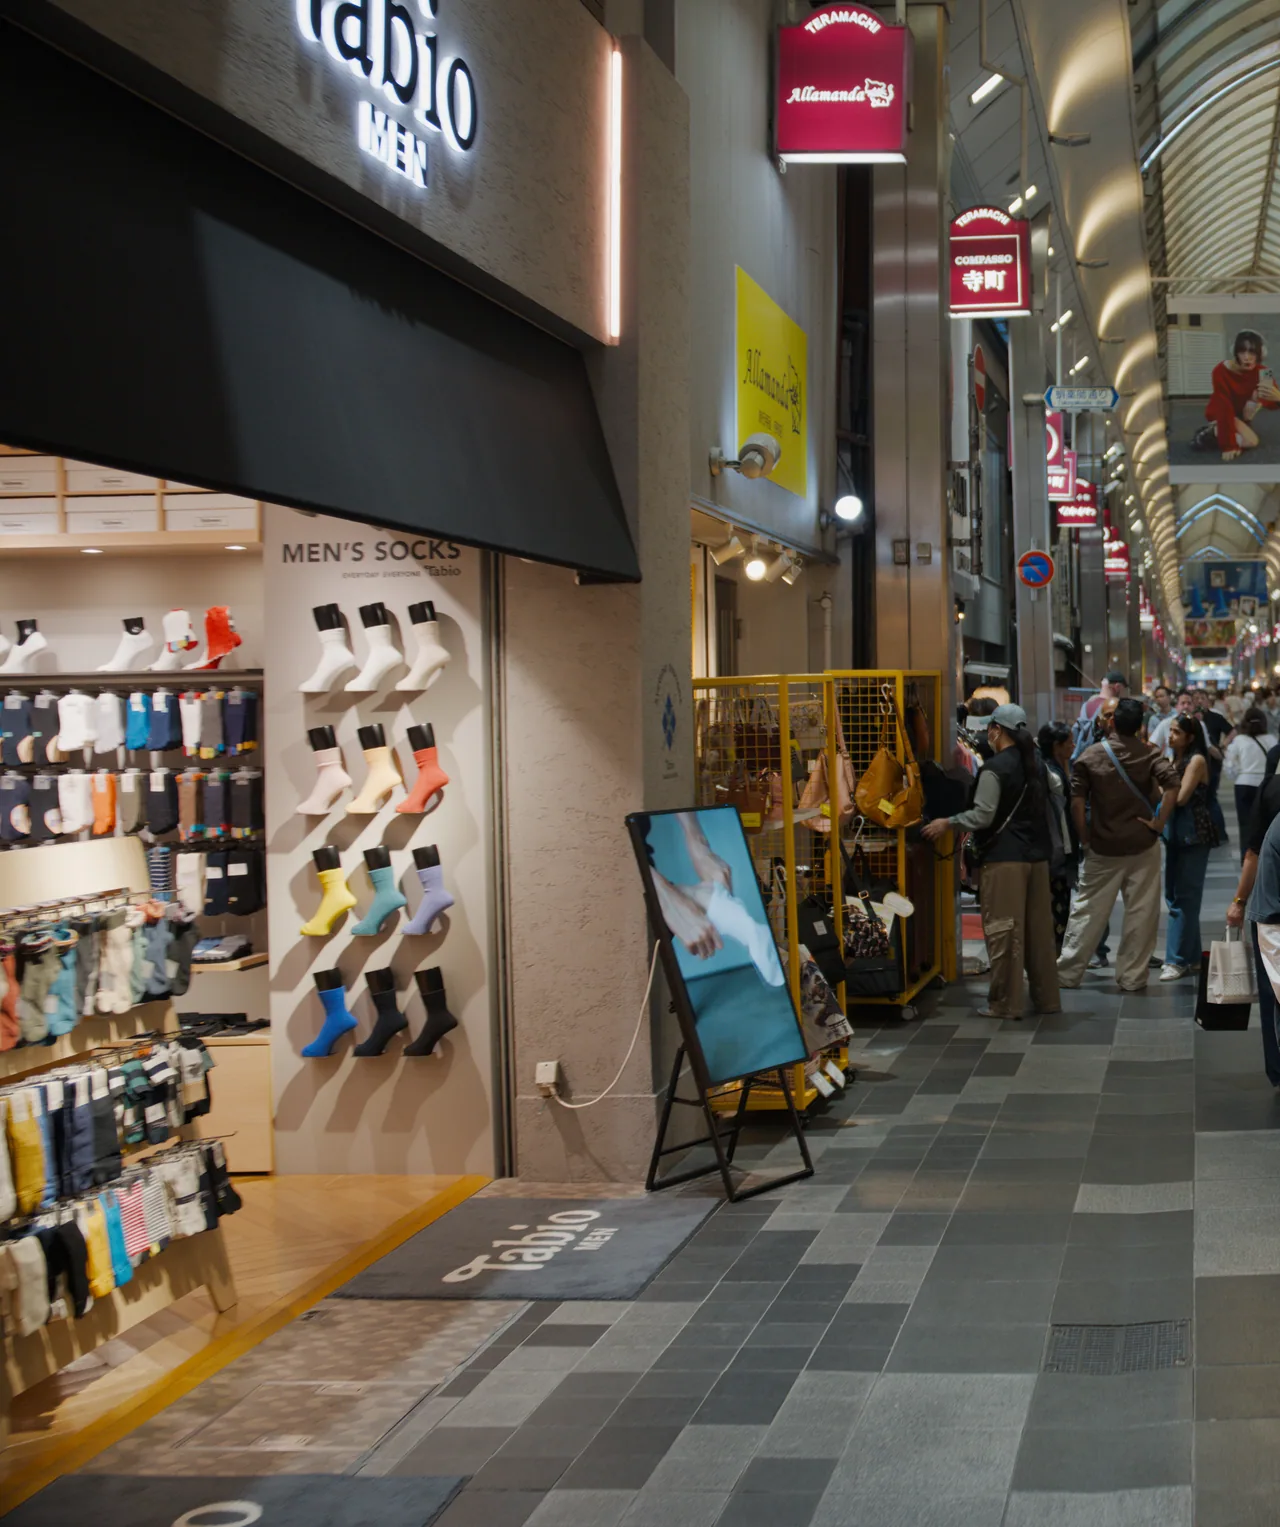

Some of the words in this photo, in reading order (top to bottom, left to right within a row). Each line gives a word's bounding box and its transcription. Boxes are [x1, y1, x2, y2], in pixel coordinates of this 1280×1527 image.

[804, 11, 882, 34] TERAMACHI
[786, 85, 866, 104] Allamanda
[358, 100, 428, 188] MEN
[955, 208, 1011, 227] TERAMACHI
[954, 254, 1013, 266] COMPASSO
[962, 269, 1007, 293] 寺町
[282, 542, 364, 563] MEN'S
[374, 541, 461, 562] SOCKS
[424, 564, 462, 577] Tabio
[441, 1209, 602, 1283] Tabio
[573, 1227, 620, 1251] MEN
